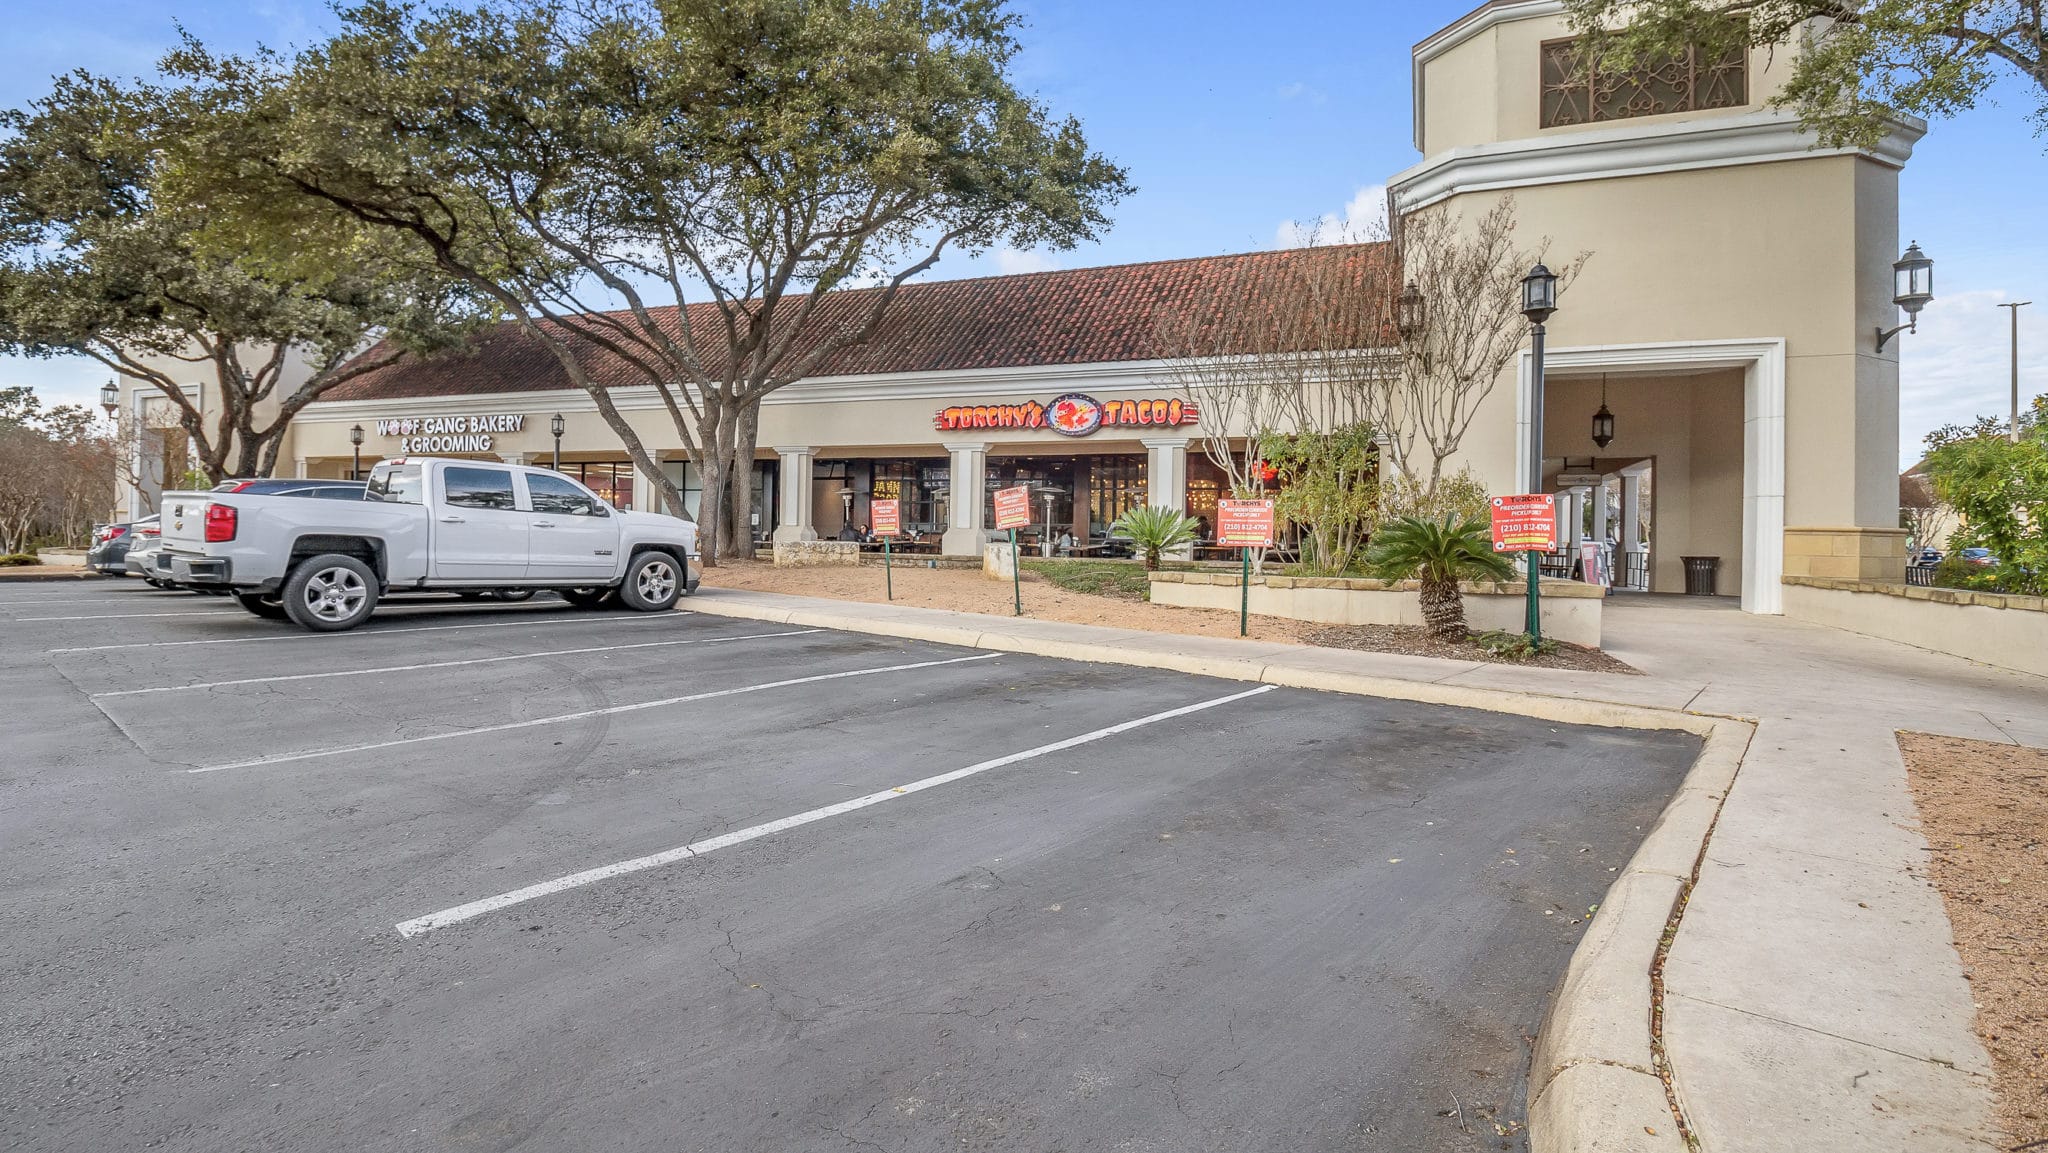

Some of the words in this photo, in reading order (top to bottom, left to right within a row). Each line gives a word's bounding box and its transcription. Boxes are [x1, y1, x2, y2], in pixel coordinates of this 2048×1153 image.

[943, 400, 1044, 428] TORCHY'S
[1104, 399, 1184, 427] TACOS
[424, 417, 469, 434] GANG
[470, 415, 525, 433] BAKERY
[401, 438, 410, 453] &
[411, 434, 493, 453] GROOMING
[1501, 524, 1521, 533] (210)
